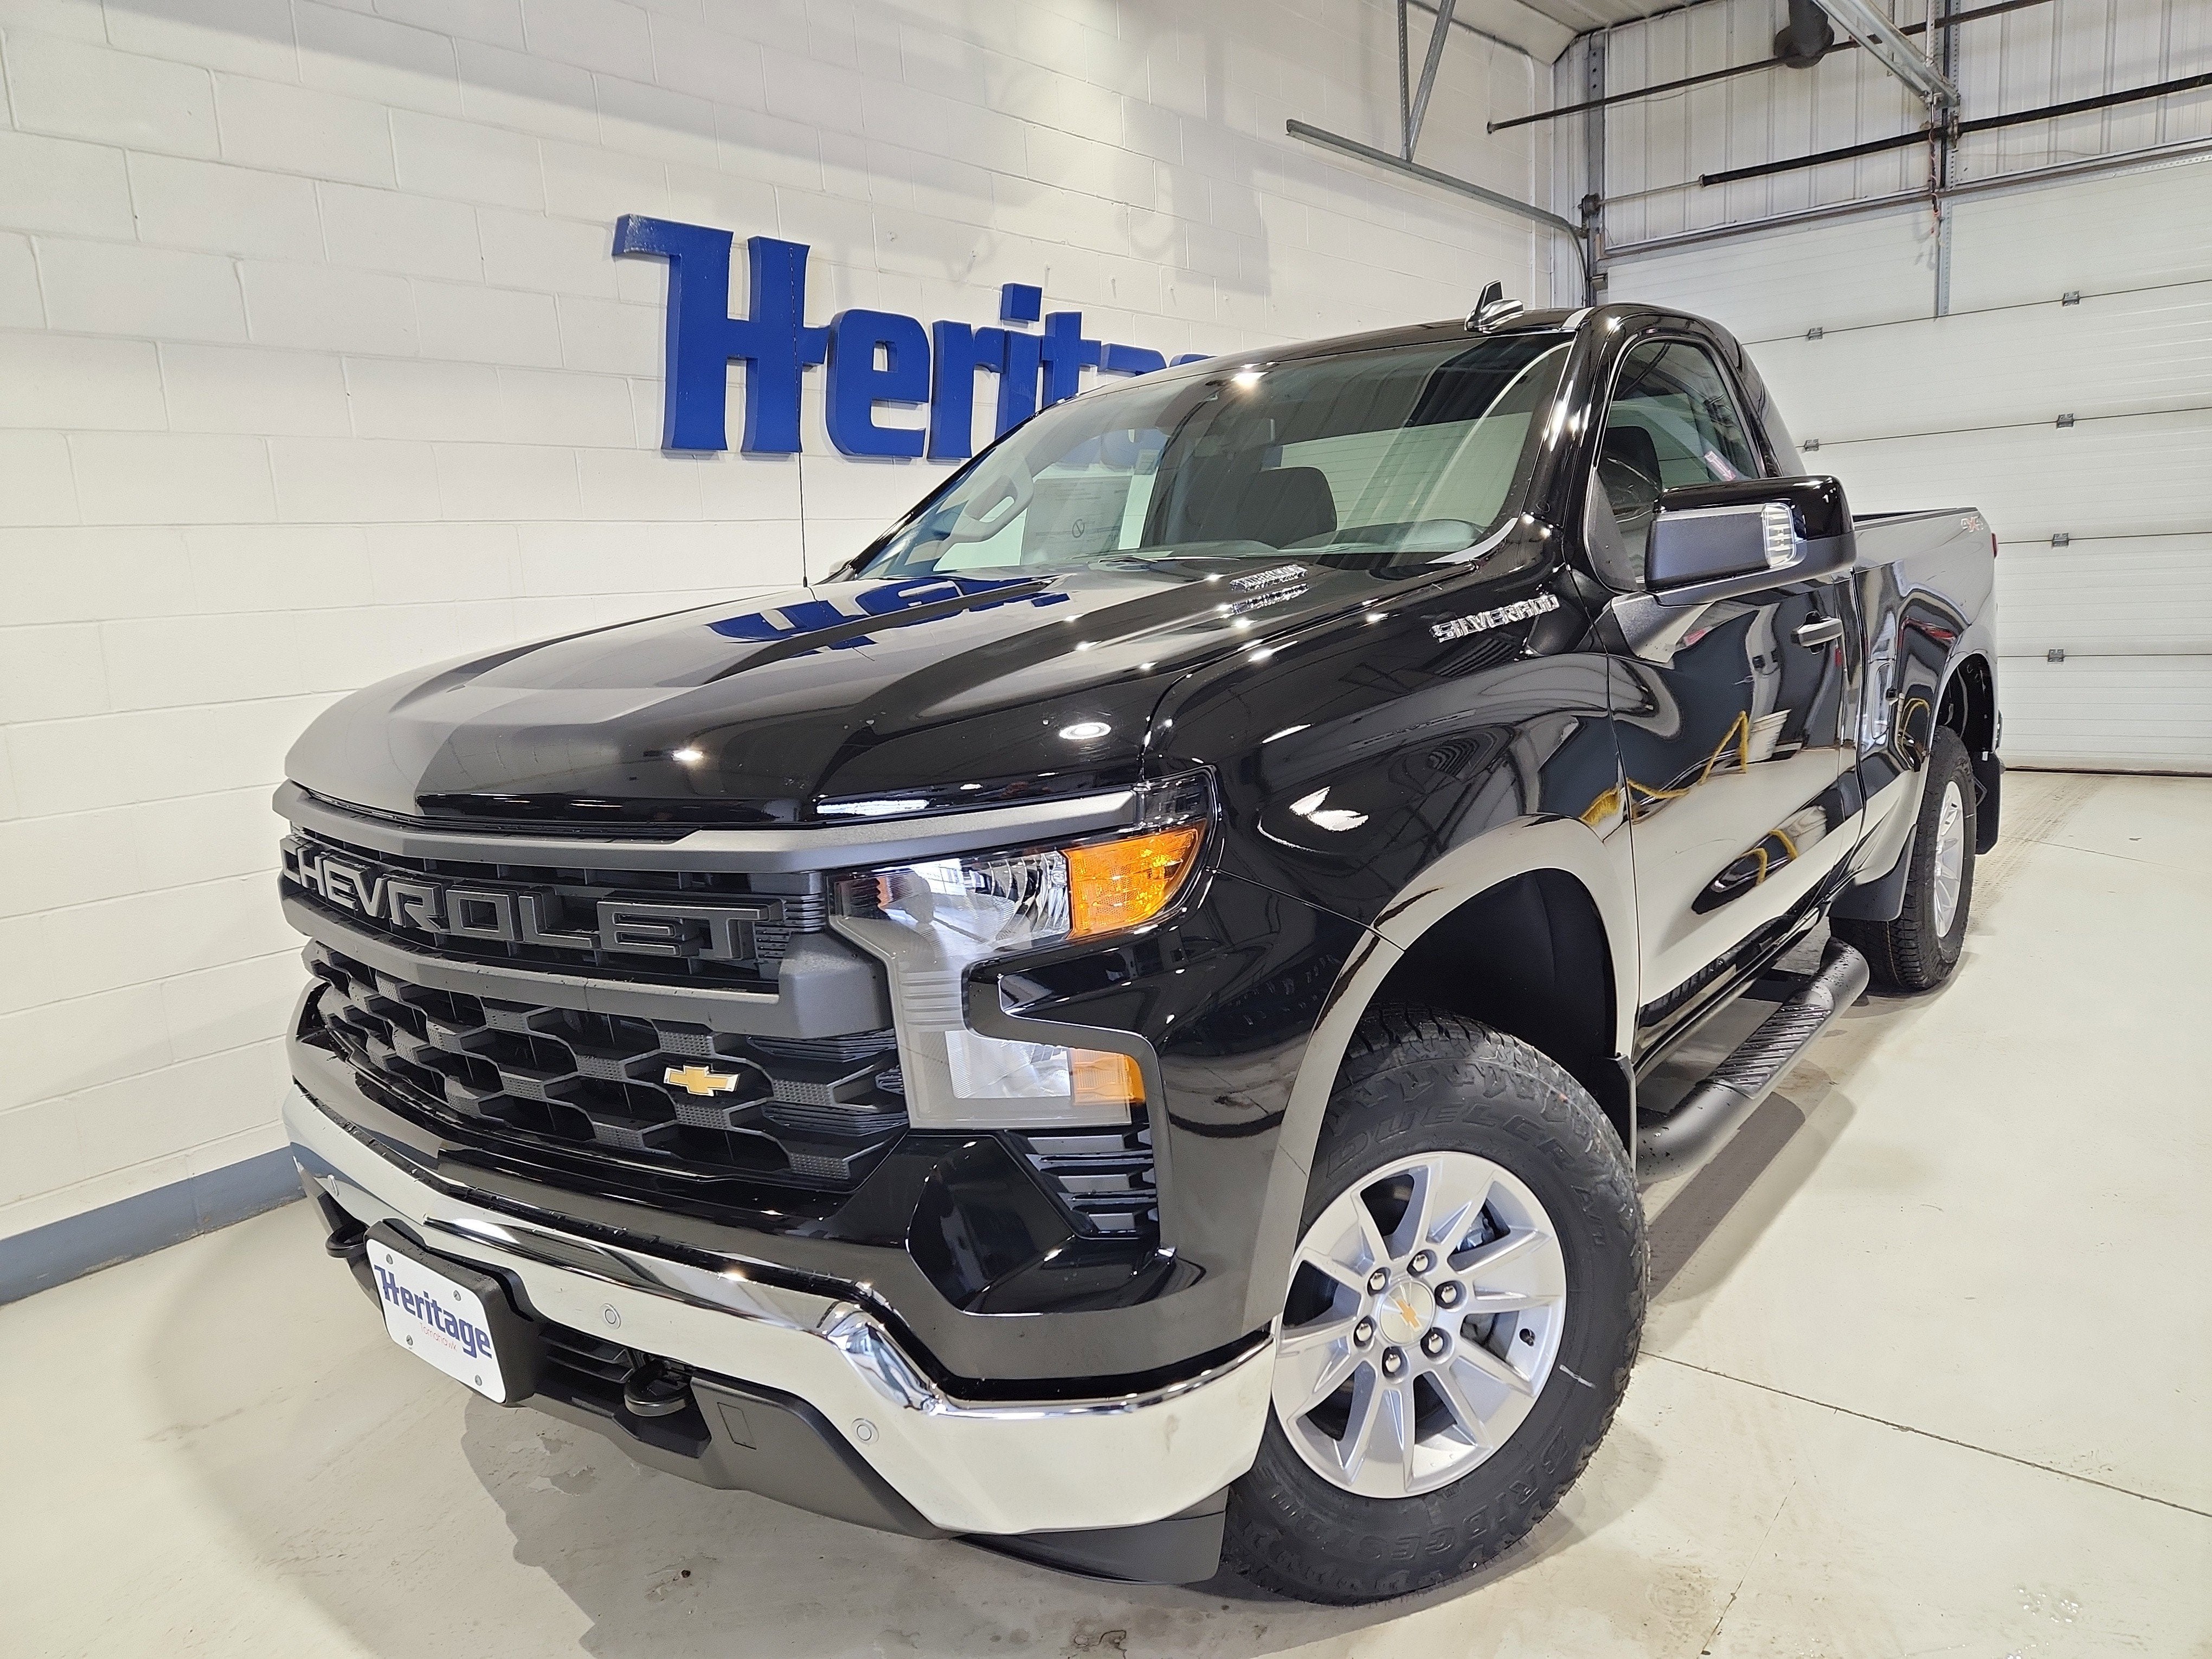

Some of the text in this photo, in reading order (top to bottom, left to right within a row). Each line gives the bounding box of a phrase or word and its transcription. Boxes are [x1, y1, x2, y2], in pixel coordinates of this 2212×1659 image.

[613, 214, 1218, 459] Herit
[1429, 594, 1560, 643] SILVERADO
[280, 838, 766, 959] CHEVROLET
[374, 1264, 493, 1359] Heritage
